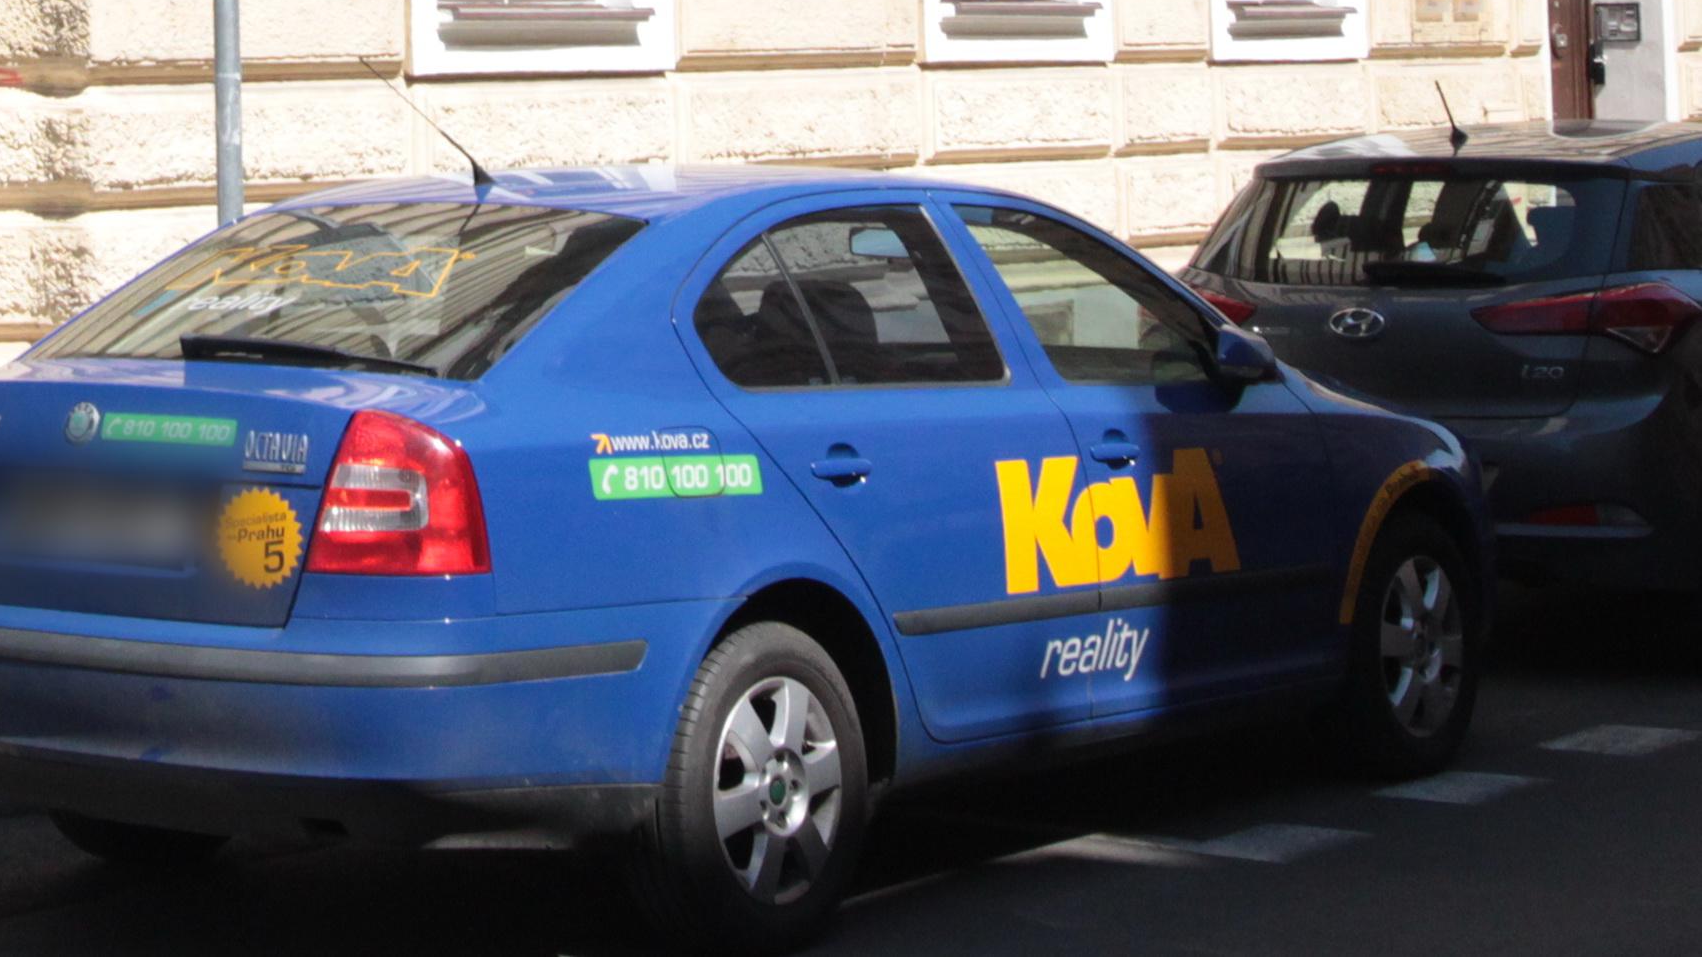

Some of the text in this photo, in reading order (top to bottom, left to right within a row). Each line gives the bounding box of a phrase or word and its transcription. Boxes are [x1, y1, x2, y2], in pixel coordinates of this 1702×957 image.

[122, 418, 232, 442] 810 100 100
[610, 430, 711, 451] www.kova.cz
[244, 429, 309, 463] OCTAVIA
[624, 462, 753, 491] 810 100 100
[237, 524, 285, 543] Prahu
[263, 539, 285, 574] 5
[1039, 617, 1150, 682] reality
